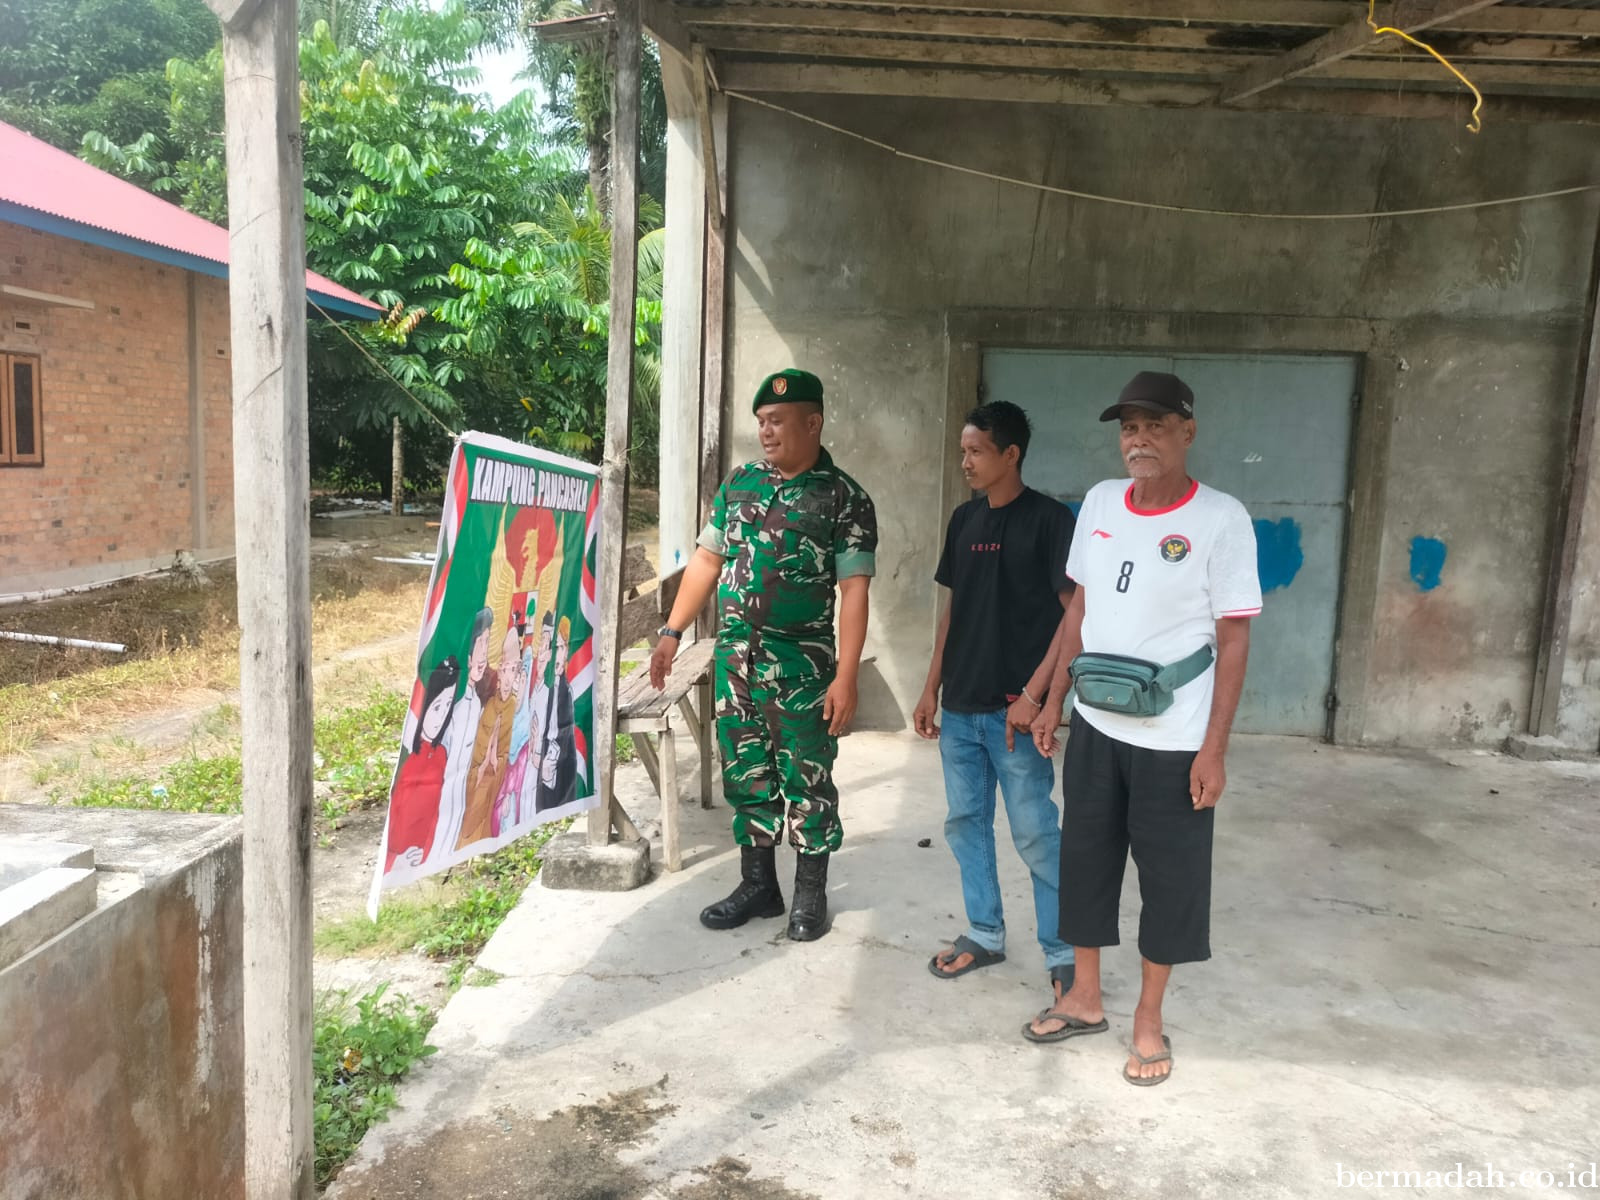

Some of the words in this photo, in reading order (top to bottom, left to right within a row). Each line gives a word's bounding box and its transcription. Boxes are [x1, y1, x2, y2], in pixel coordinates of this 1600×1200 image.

[470, 457, 536, 506] KAMPUNG
[537, 470, 589, 512] PANCASILA
[1116, 560, 1134, 594] 8
